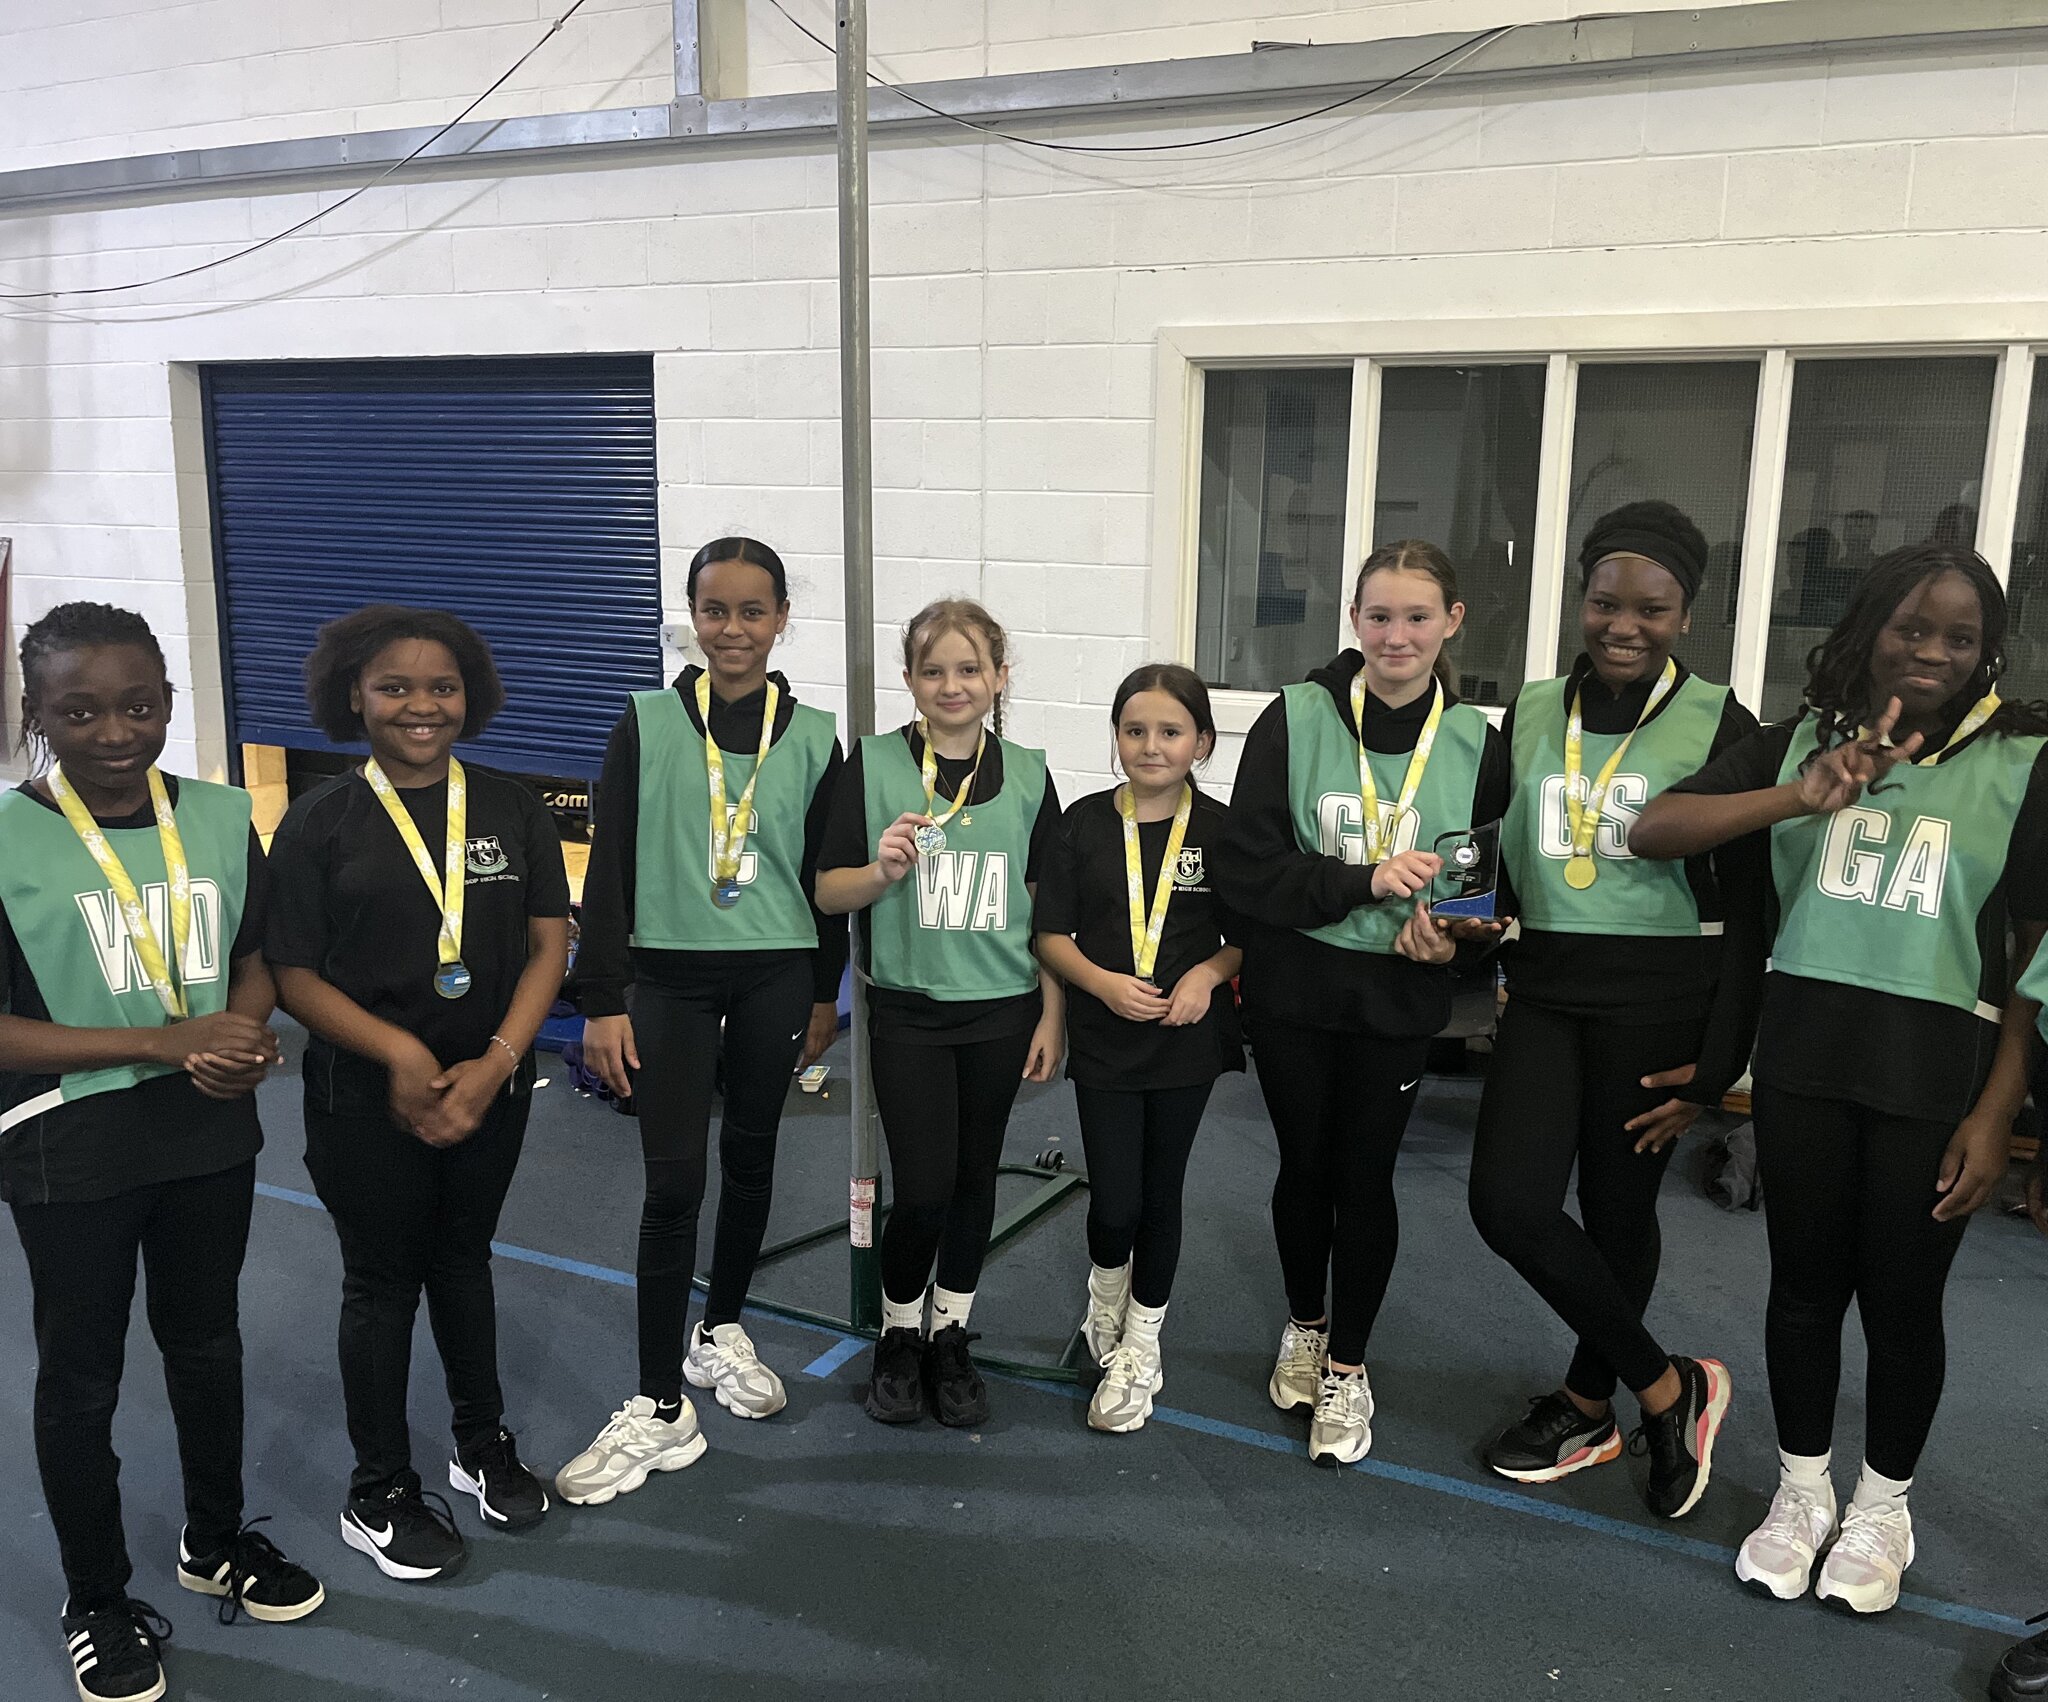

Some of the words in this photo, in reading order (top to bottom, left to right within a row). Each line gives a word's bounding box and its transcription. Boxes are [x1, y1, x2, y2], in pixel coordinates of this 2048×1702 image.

[708, 803, 758, 885] C
[1317, 791, 1421, 866] GD
[1539, 773, 1648, 859] GS
[915, 850, 1008, 931] WA
[1817, 805, 1952, 919] GA
[73, 877, 222, 996] WD
